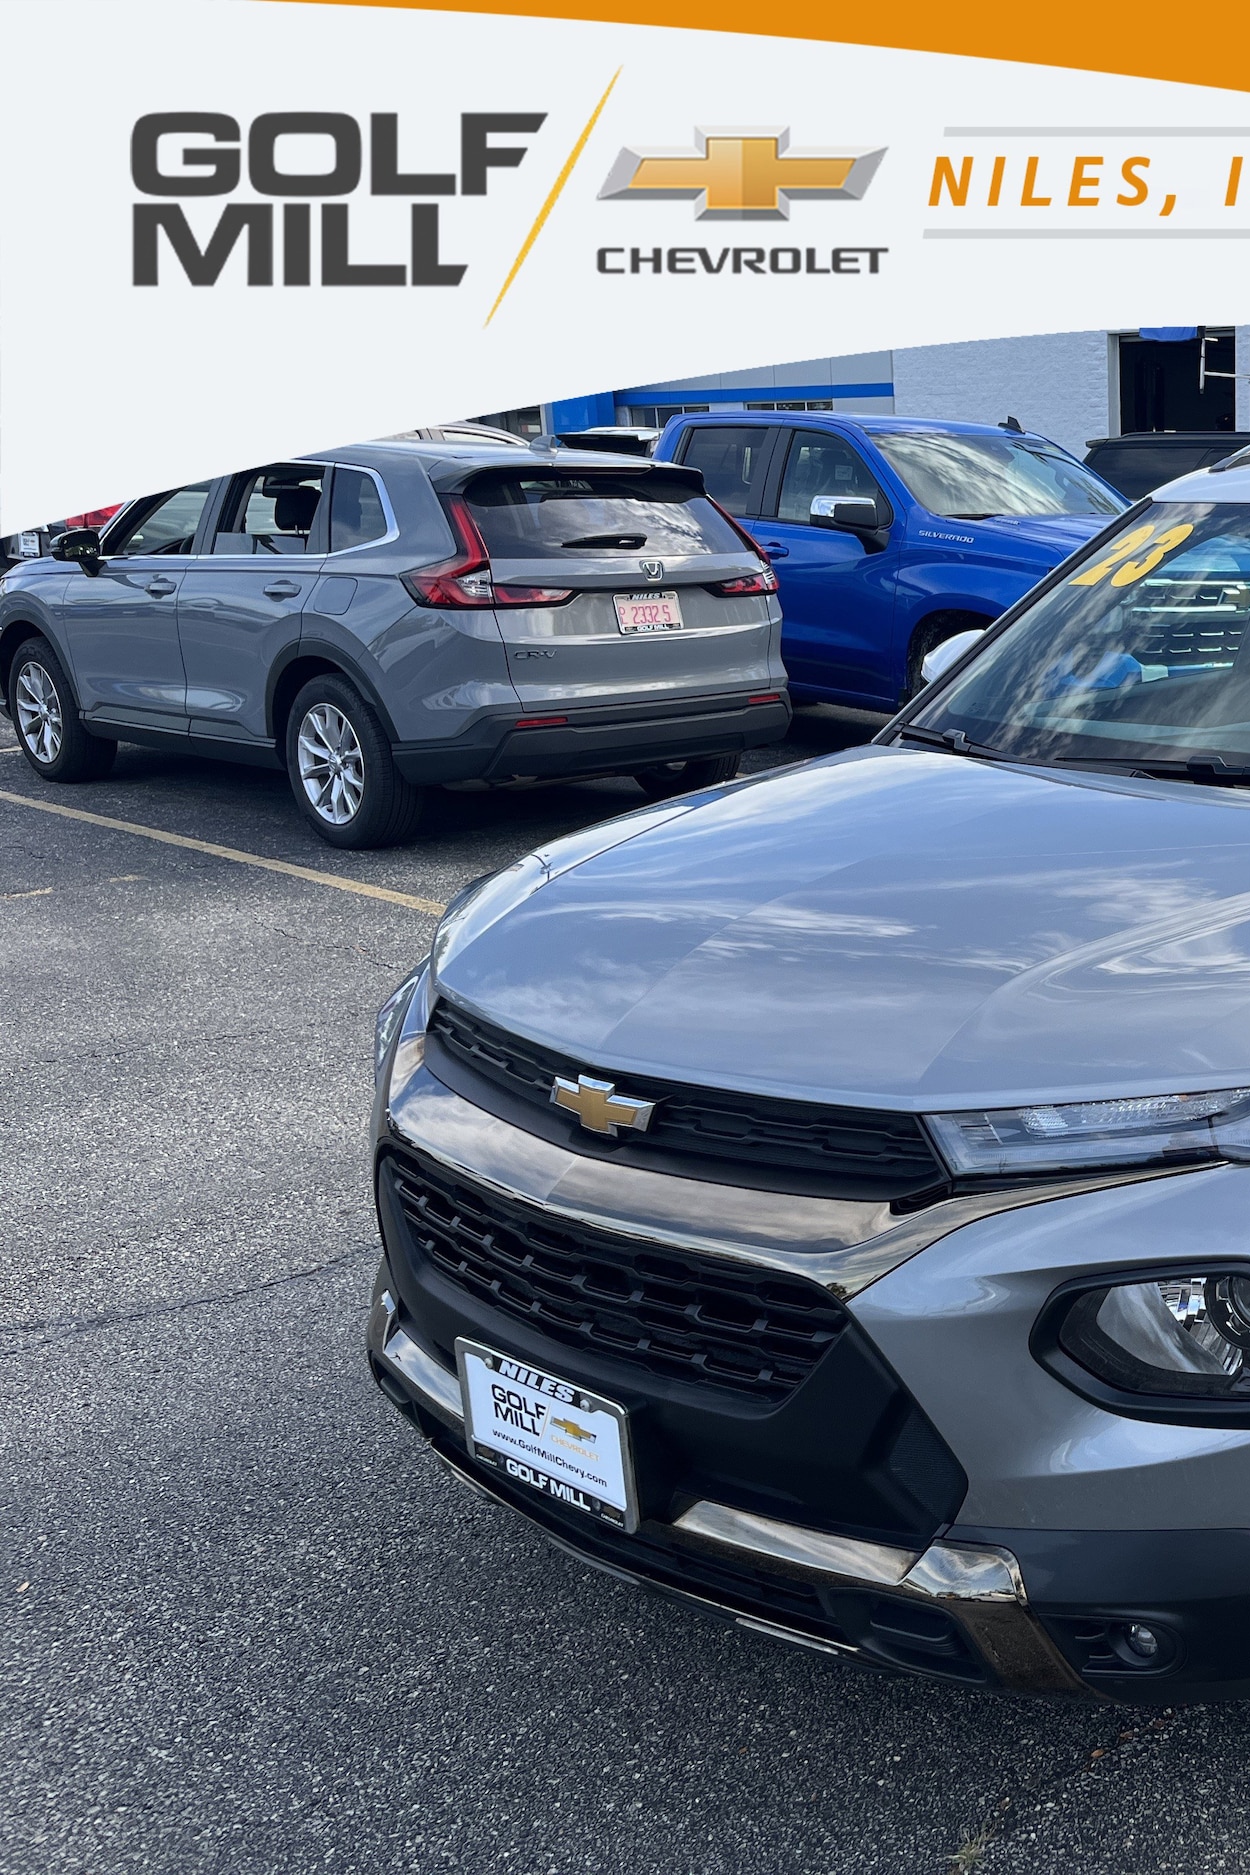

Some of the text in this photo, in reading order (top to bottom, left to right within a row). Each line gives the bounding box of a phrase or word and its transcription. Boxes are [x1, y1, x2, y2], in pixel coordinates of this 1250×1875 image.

[919, 530, 975, 544] SILVERADO
[1067, 523, 1194, 588] 23
[632, 592, 661, 600] NILES
[631, 605, 661, 624] 2332
[514, 649, 557, 660] CR-V
[499, 1359, 576, 1403] NILES
[491, 1384, 547, 1419] GOLF
[494, 1402, 541, 1437] MILL
[492, 1428, 608, 1487] www.GolfMillChevy.com
[550, 1435, 600, 1461] CHEVROLET
[506, 1458, 591, 1511] GOLF MILL
